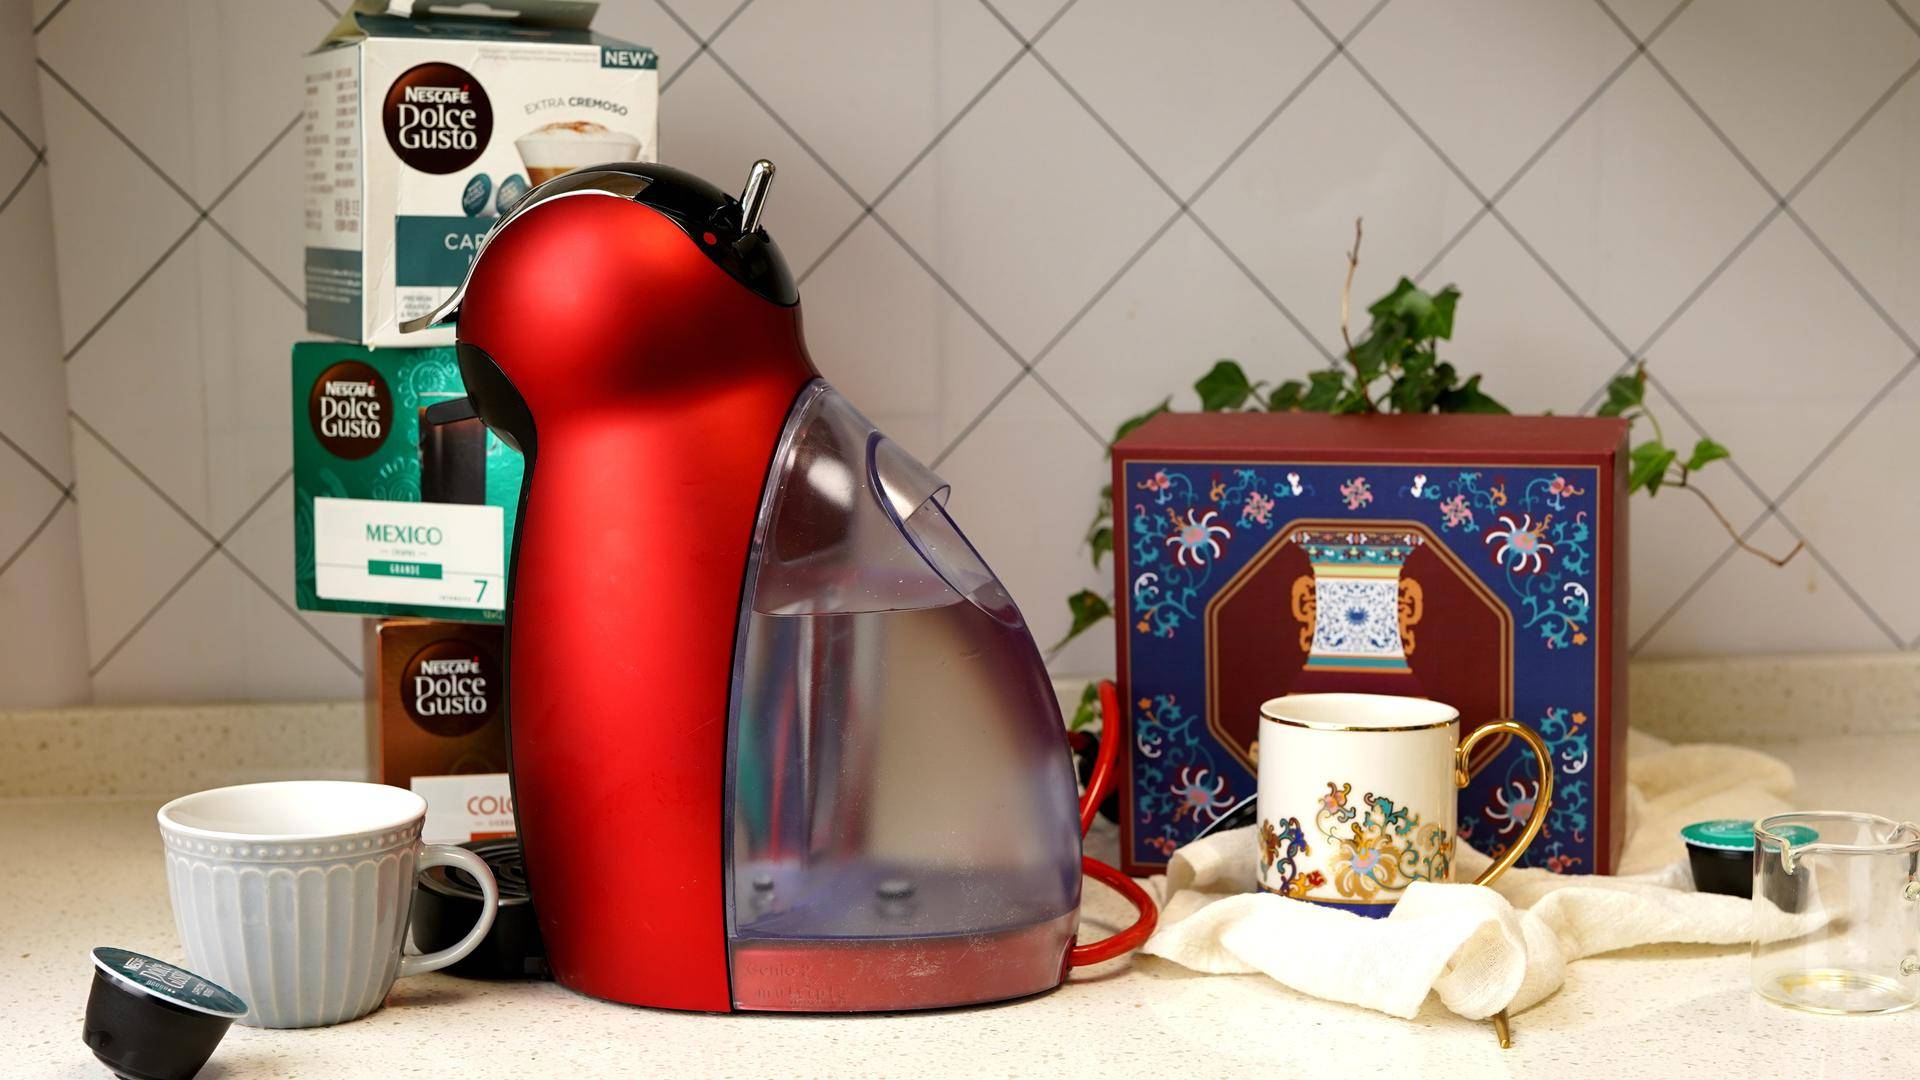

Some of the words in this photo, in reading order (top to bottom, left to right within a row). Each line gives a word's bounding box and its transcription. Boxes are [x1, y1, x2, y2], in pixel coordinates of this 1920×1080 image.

[405, 83, 471, 104] NESCAFÉ
[397, 103, 477, 129] Dolce
[524, 98, 566, 115] EXTRA
[568, 97, 628, 116] CREMOSO
[399, 124, 477, 150] Gusto
[320, 396, 381, 420] Dolce
[321, 416, 381, 439] Gusto
[366, 523, 443, 546] MEXICO
[389, 563, 421, 576] GRANDE
[473, 579, 488, 603] 7
[415, 674, 487, 697] Dolce
[416, 694, 487, 717] Gusto
